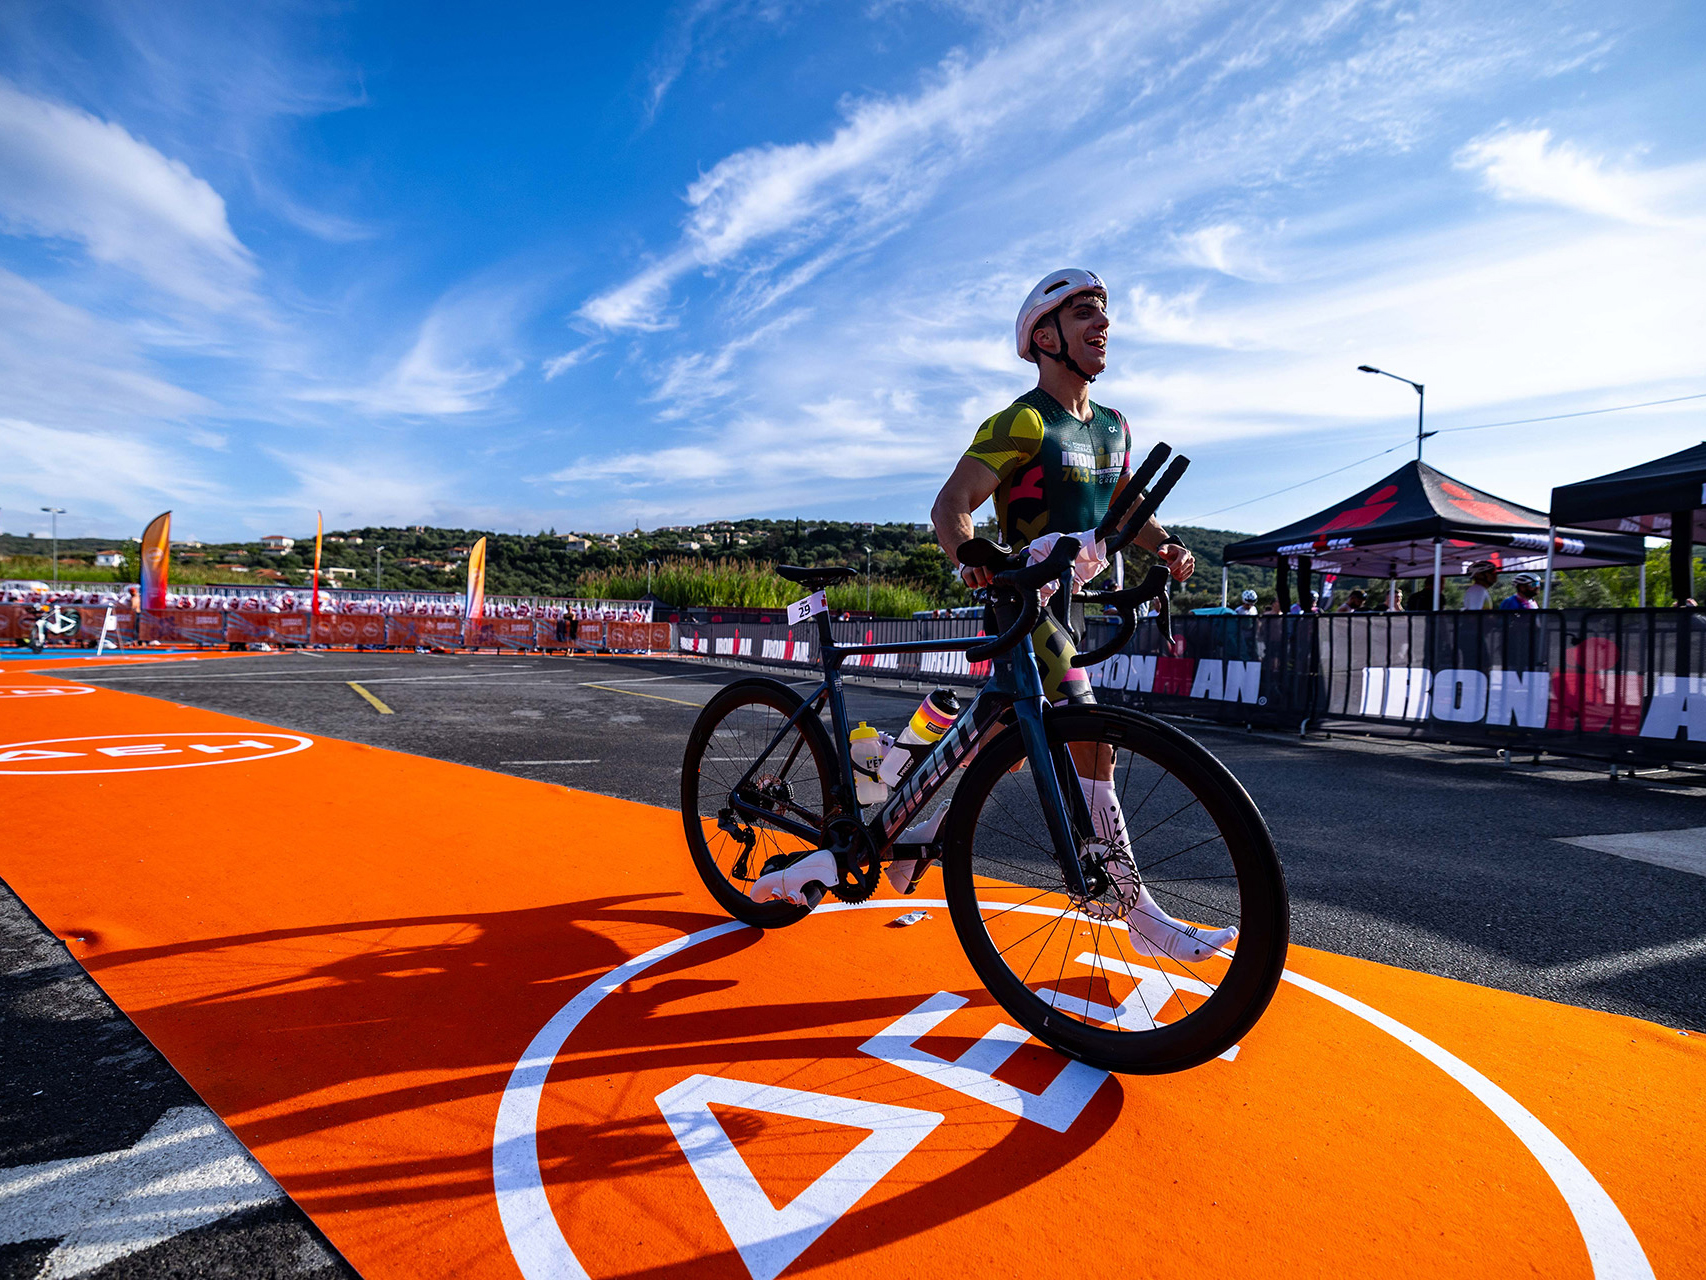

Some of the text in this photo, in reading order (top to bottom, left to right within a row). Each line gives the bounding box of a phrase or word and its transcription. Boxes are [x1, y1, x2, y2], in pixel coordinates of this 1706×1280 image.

[1062, 467, 1090, 483] 70.3
[798, 604, 810, 618] 29
[1360, 637, 1706, 742] IRONMA
[882, 696, 979, 839] GIANT
